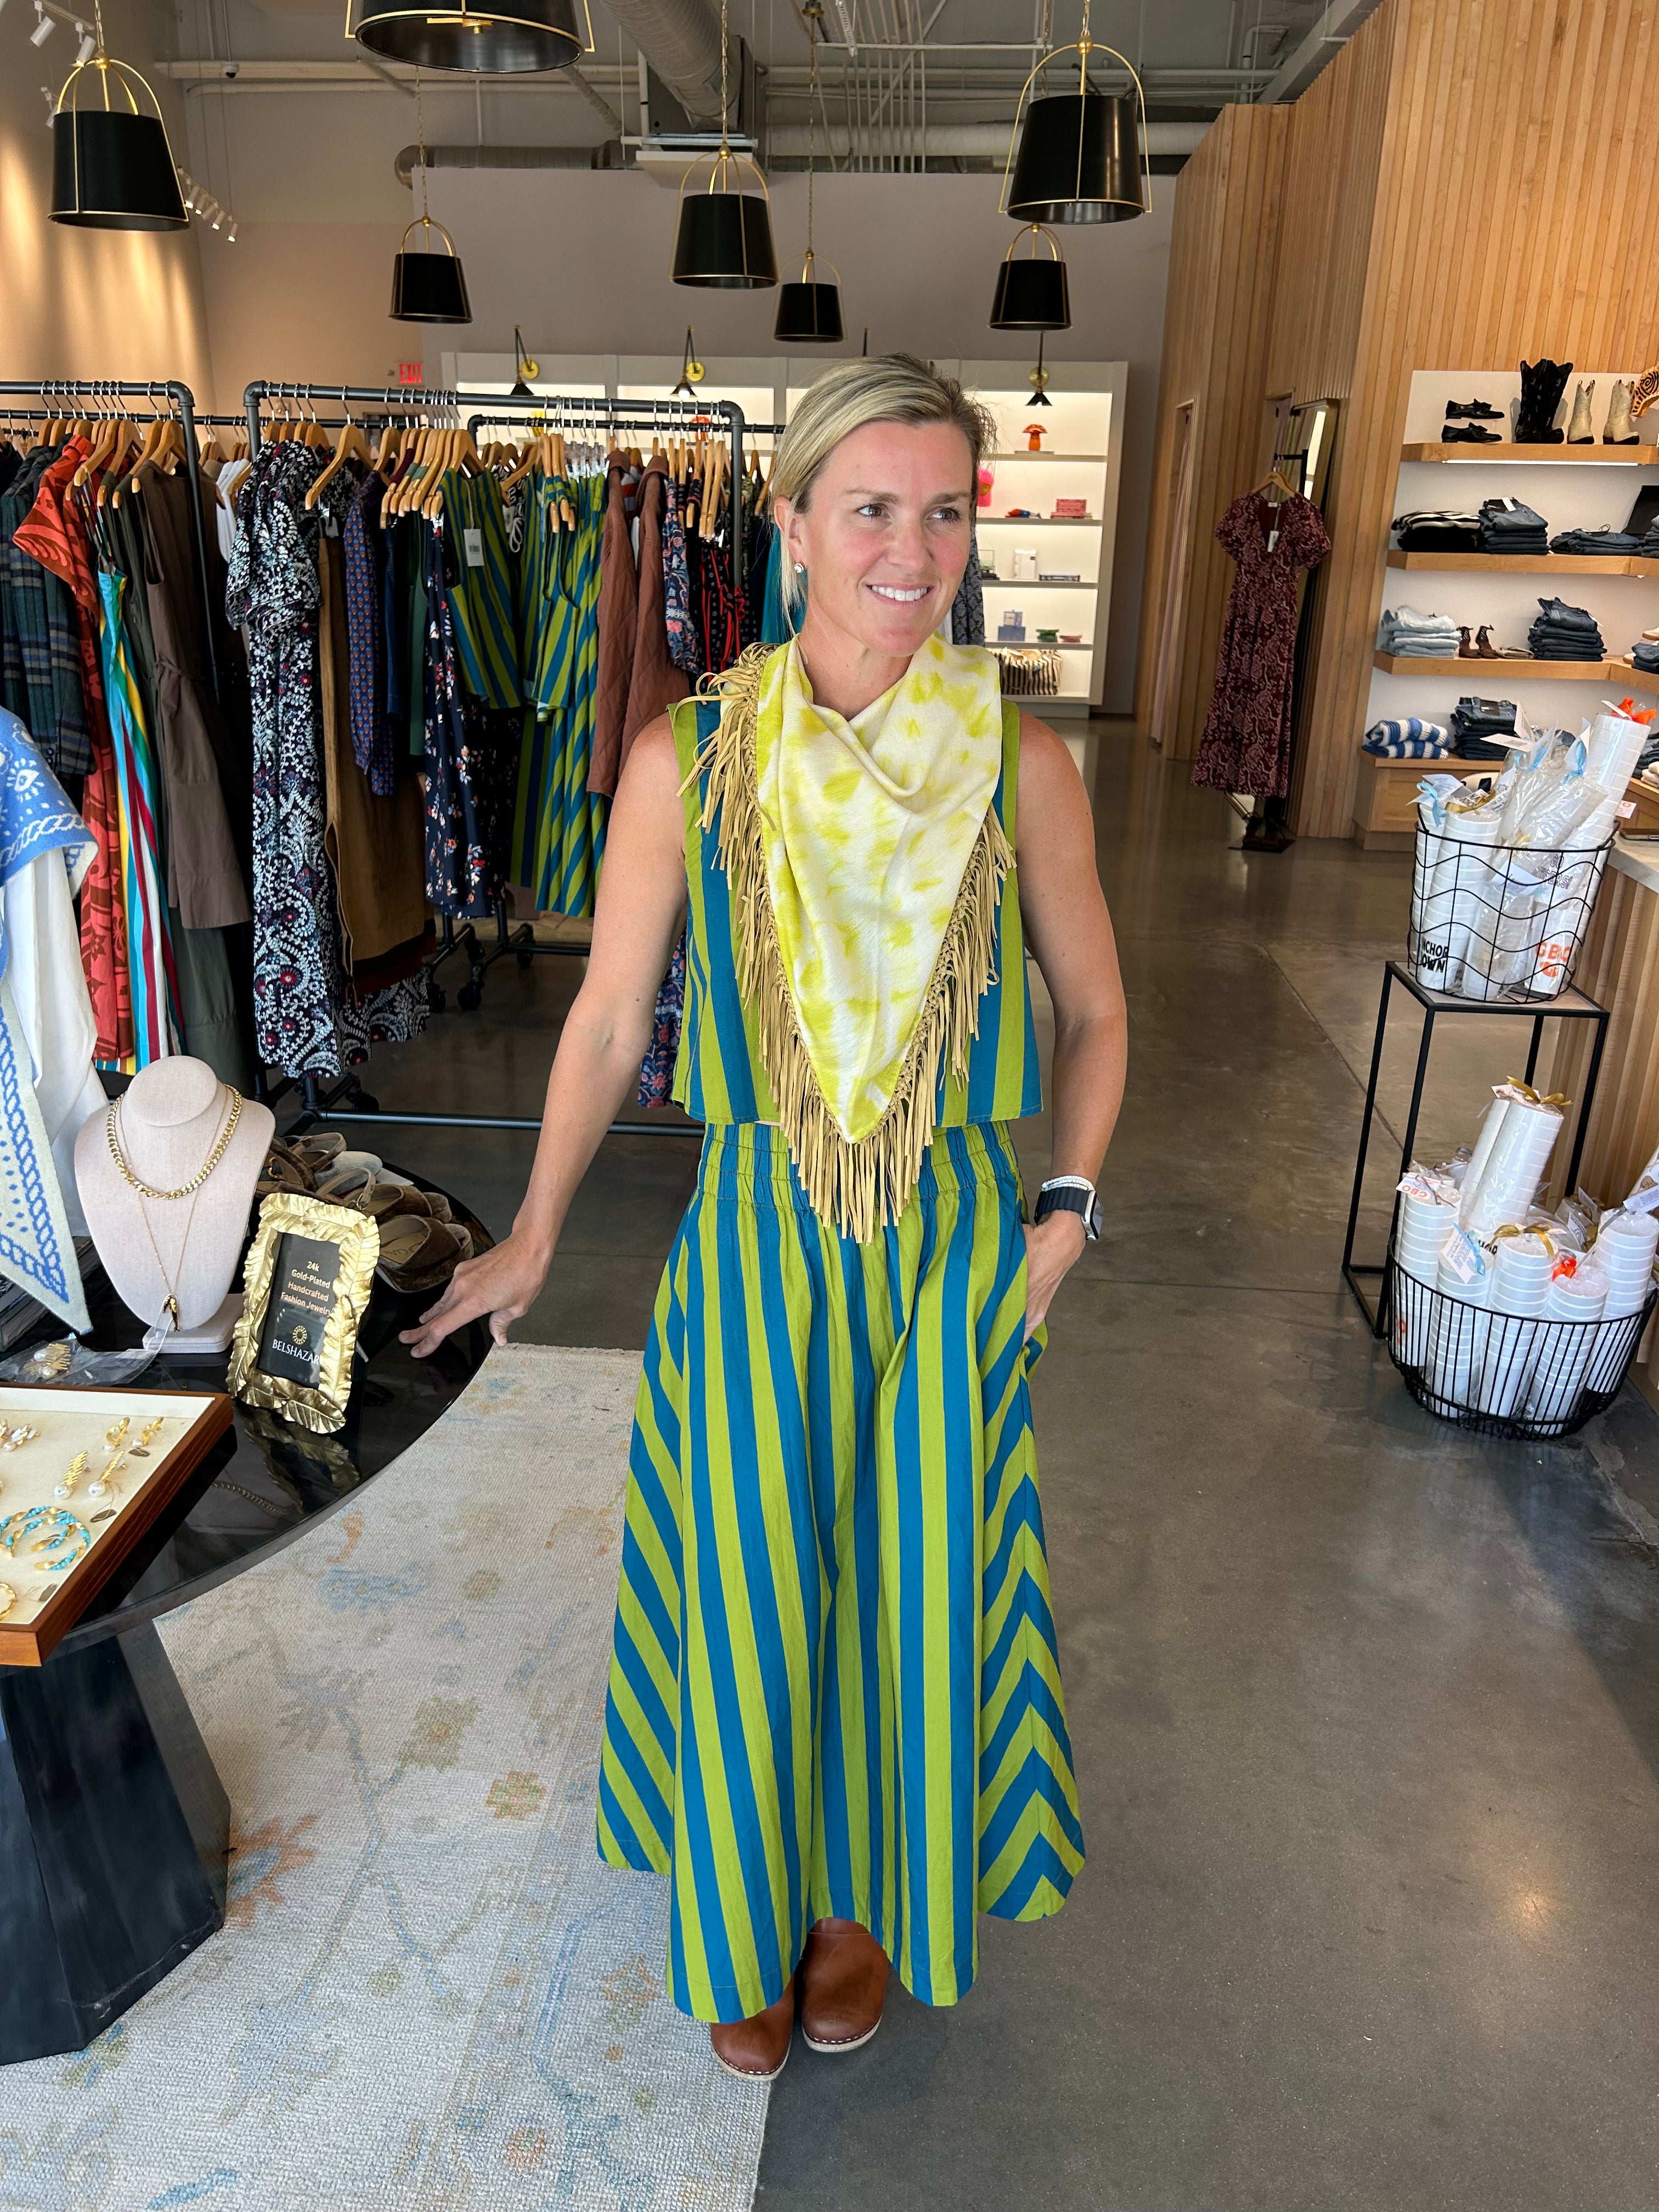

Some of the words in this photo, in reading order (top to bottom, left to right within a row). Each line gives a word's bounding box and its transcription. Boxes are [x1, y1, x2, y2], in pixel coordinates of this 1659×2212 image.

[399, 364, 422, 383] EXIT
[1421, 937, 1449, 958] NCHOR
[1421, 952, 1447, 973] OWN
[307, 1261, 320, 1272] 24k
[291, 1269, 331, 1289] Gold-Plated
[280, 1291, 306, 1307] Fashion
[287, 1281, 330, 1302] Handcrafted
[272, 1339, 320, 1365] BELSHAZAR
